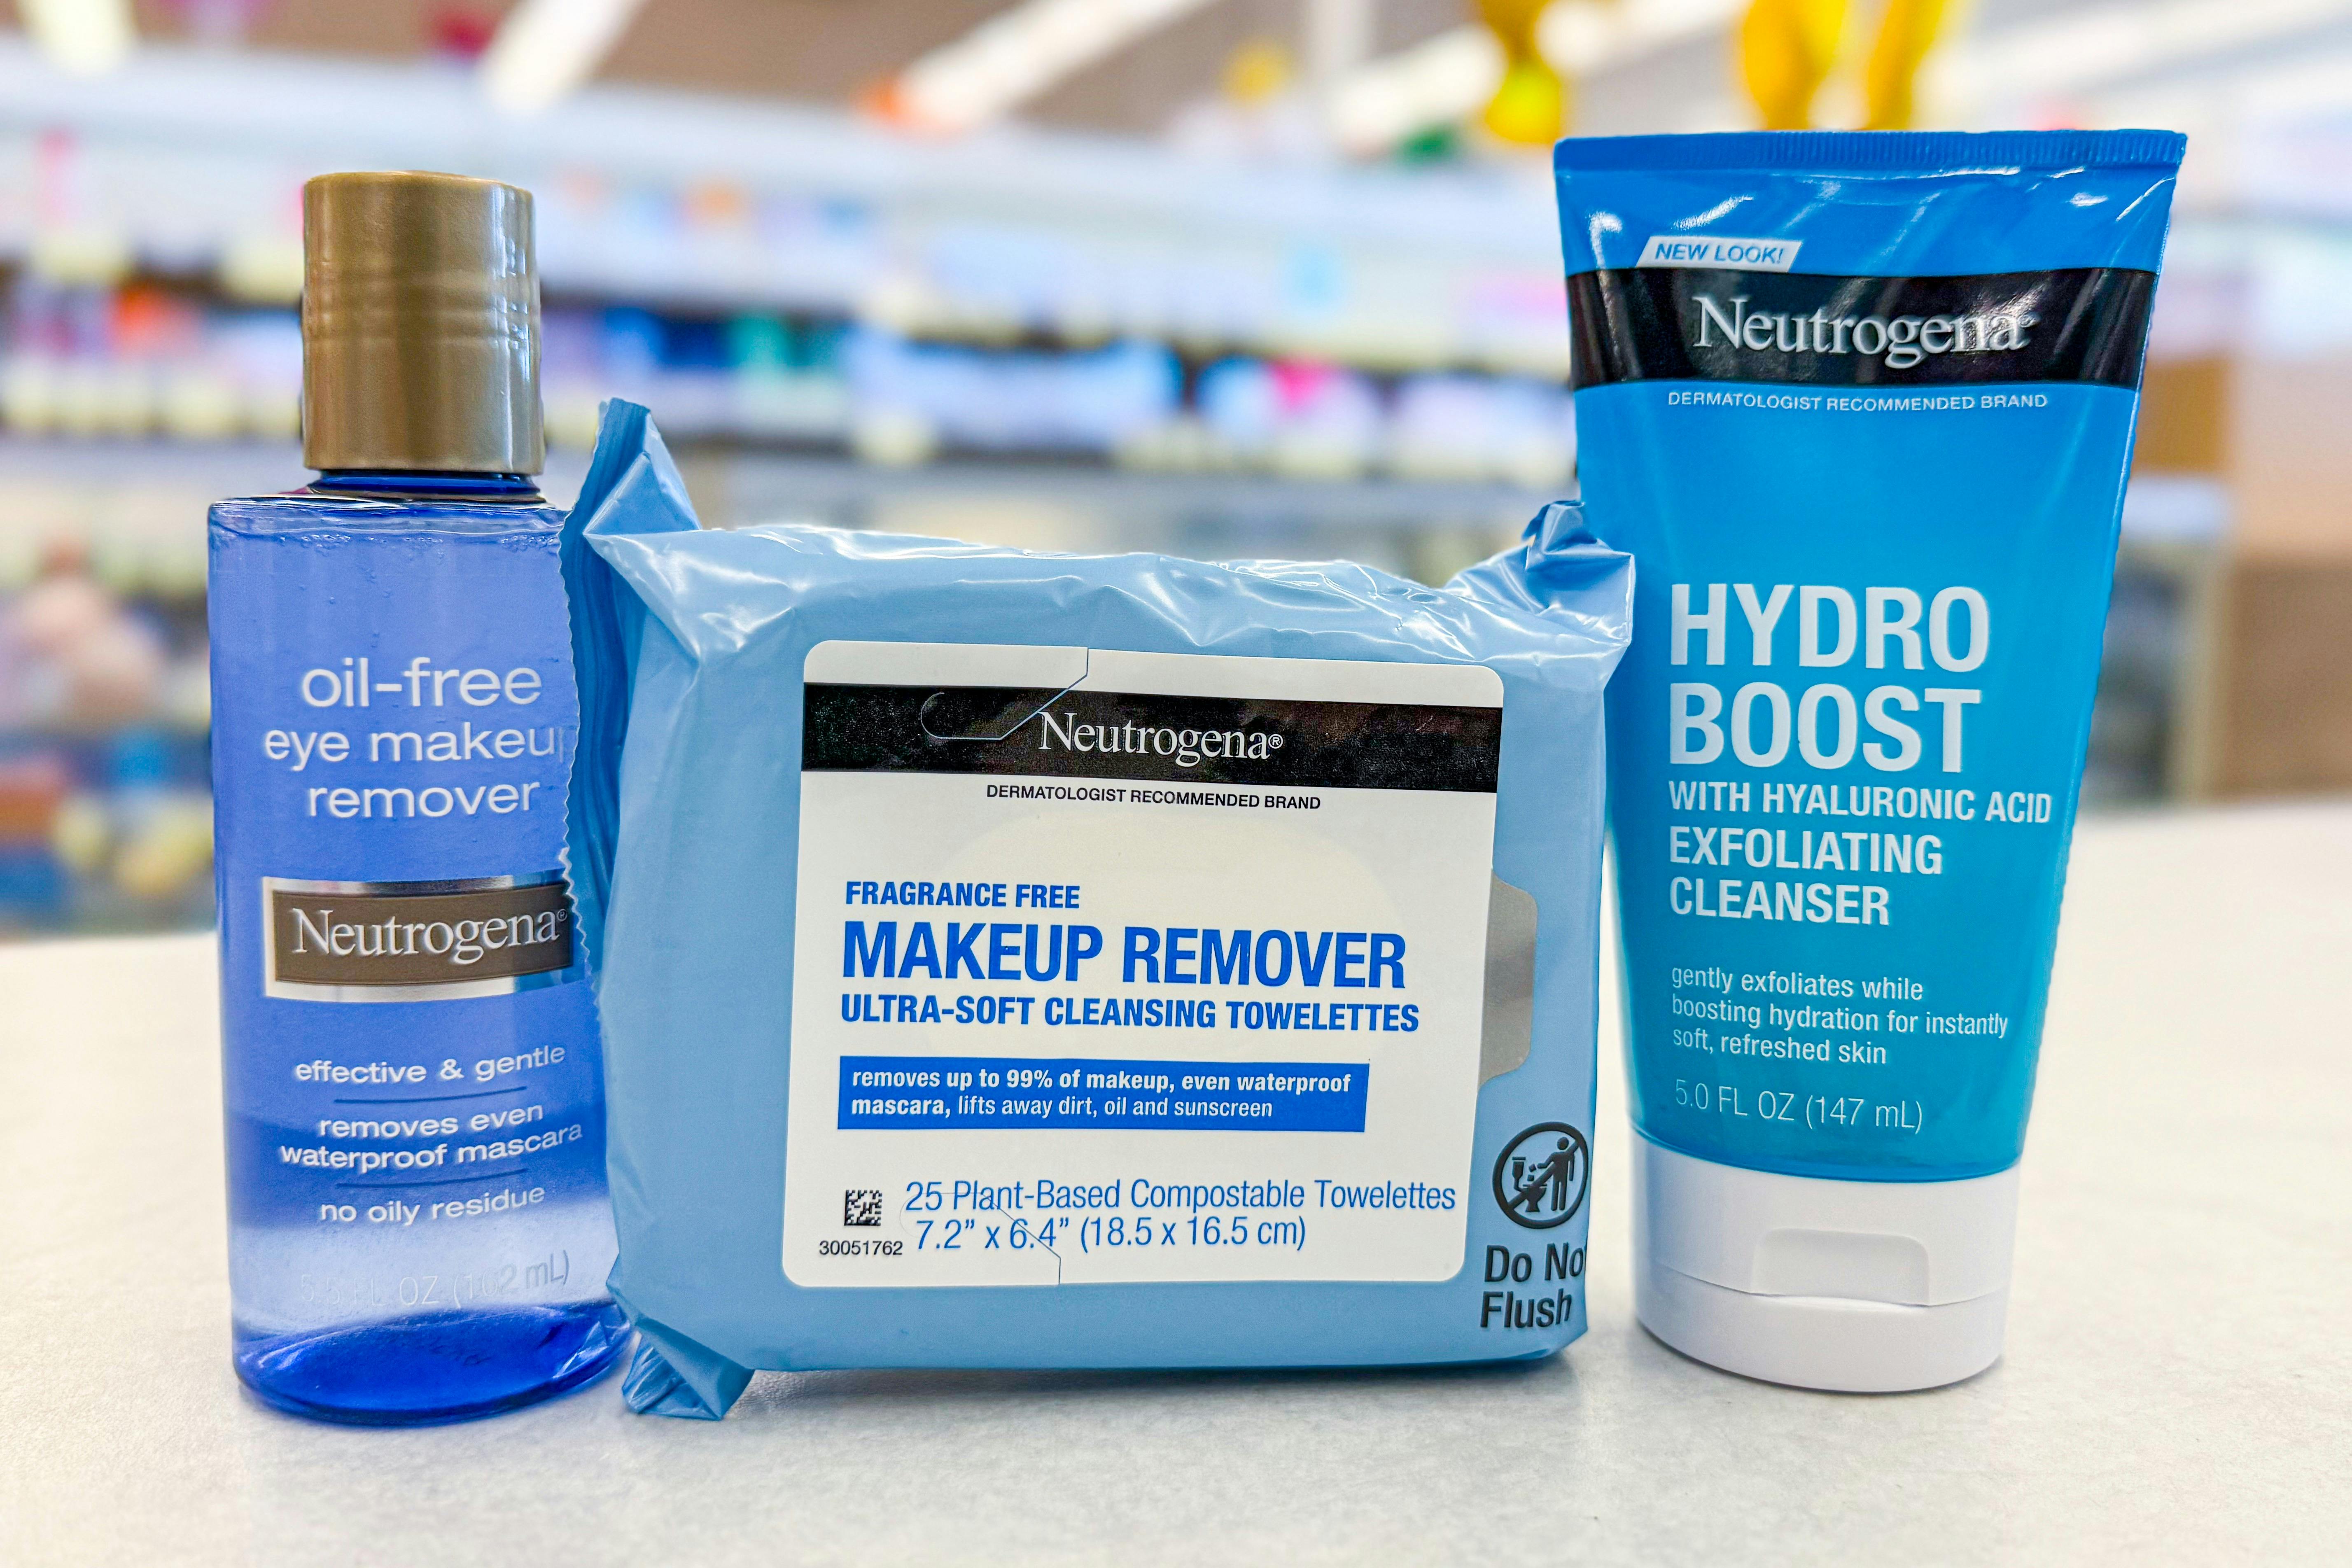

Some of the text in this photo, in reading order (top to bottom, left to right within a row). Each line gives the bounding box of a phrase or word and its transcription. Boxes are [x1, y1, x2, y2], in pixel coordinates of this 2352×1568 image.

[1654, 243, 1784, 265] NEW LOOK!
[1668, 392, 2048, 412] DERMATOLOGIST RECOMMENDED BRAND
[1671, 583, 1990, 672] HYDRO
[301, 658, 541, 707] oil-free
[1669, 681, 1981, 773] BOOST
[265, 729, 349, 771] eye
[308, 782, 539, 818] remover
[987, 784, 1321, 810] DERMATOLOGIST RECOMMENDED BRAND
[1668, 781, 2052, 823] WITH HYALURONIC ACID
[1669, 826, 1942, 875] EXFOLIATING
[846, 881, 1080, 909] FRAGRANCE FREE
[1670, 877, 1889, 925] CLEANSER
[842, 921, 1406, 989] MAKEUP REMOVER
[1671, 966, 1923, 1001] gently exfoliates while
[841, 994, 1419, 1032] ULTRA-SOFT CLEANSING TOWELETTES
[1672, 994, 2008, 1039] boosting hydration for instantly
[296, 1045, 565, 1084] effective & gentle
[1673, 1027, 1887, 1065] soft, refreshed skin
[852, 1069, 1351, 1094] removes up to 99% of makeup, even waterproof
[320, 1104, 543, 1138] removes even
[852, 1095, 1273, 1119] mascara, lifts away dirt, oil and sunscreen
[1674, 1078, 1923, 1134] 5.0 FL OZ (147 mL)
[281, 1123, 583, 1173] waterproof mascara
[322, 1186, 545, 1226] no oily residue
[905, 1178, 1456, 1214] 25 Plant-Based Compostable Towelettes
[819, 1240, 903, 1256] 30051762
[985, 1224, 1000, 1249] x
[1080, 1216, 1153, 1254] (18.5
[1161, 1221, 1176, 1246] x
[1188, 1216, 1248, 1246] 16.5
[1258, 1216, 1306, 1251] cm)
[399, 1275, 440, 1306] OZ
[525, 1249, 570, 1289] mL)
[1484, 1242, 1586, 1282] Do No
[1480, 1288, 1572, 1328] Flush
